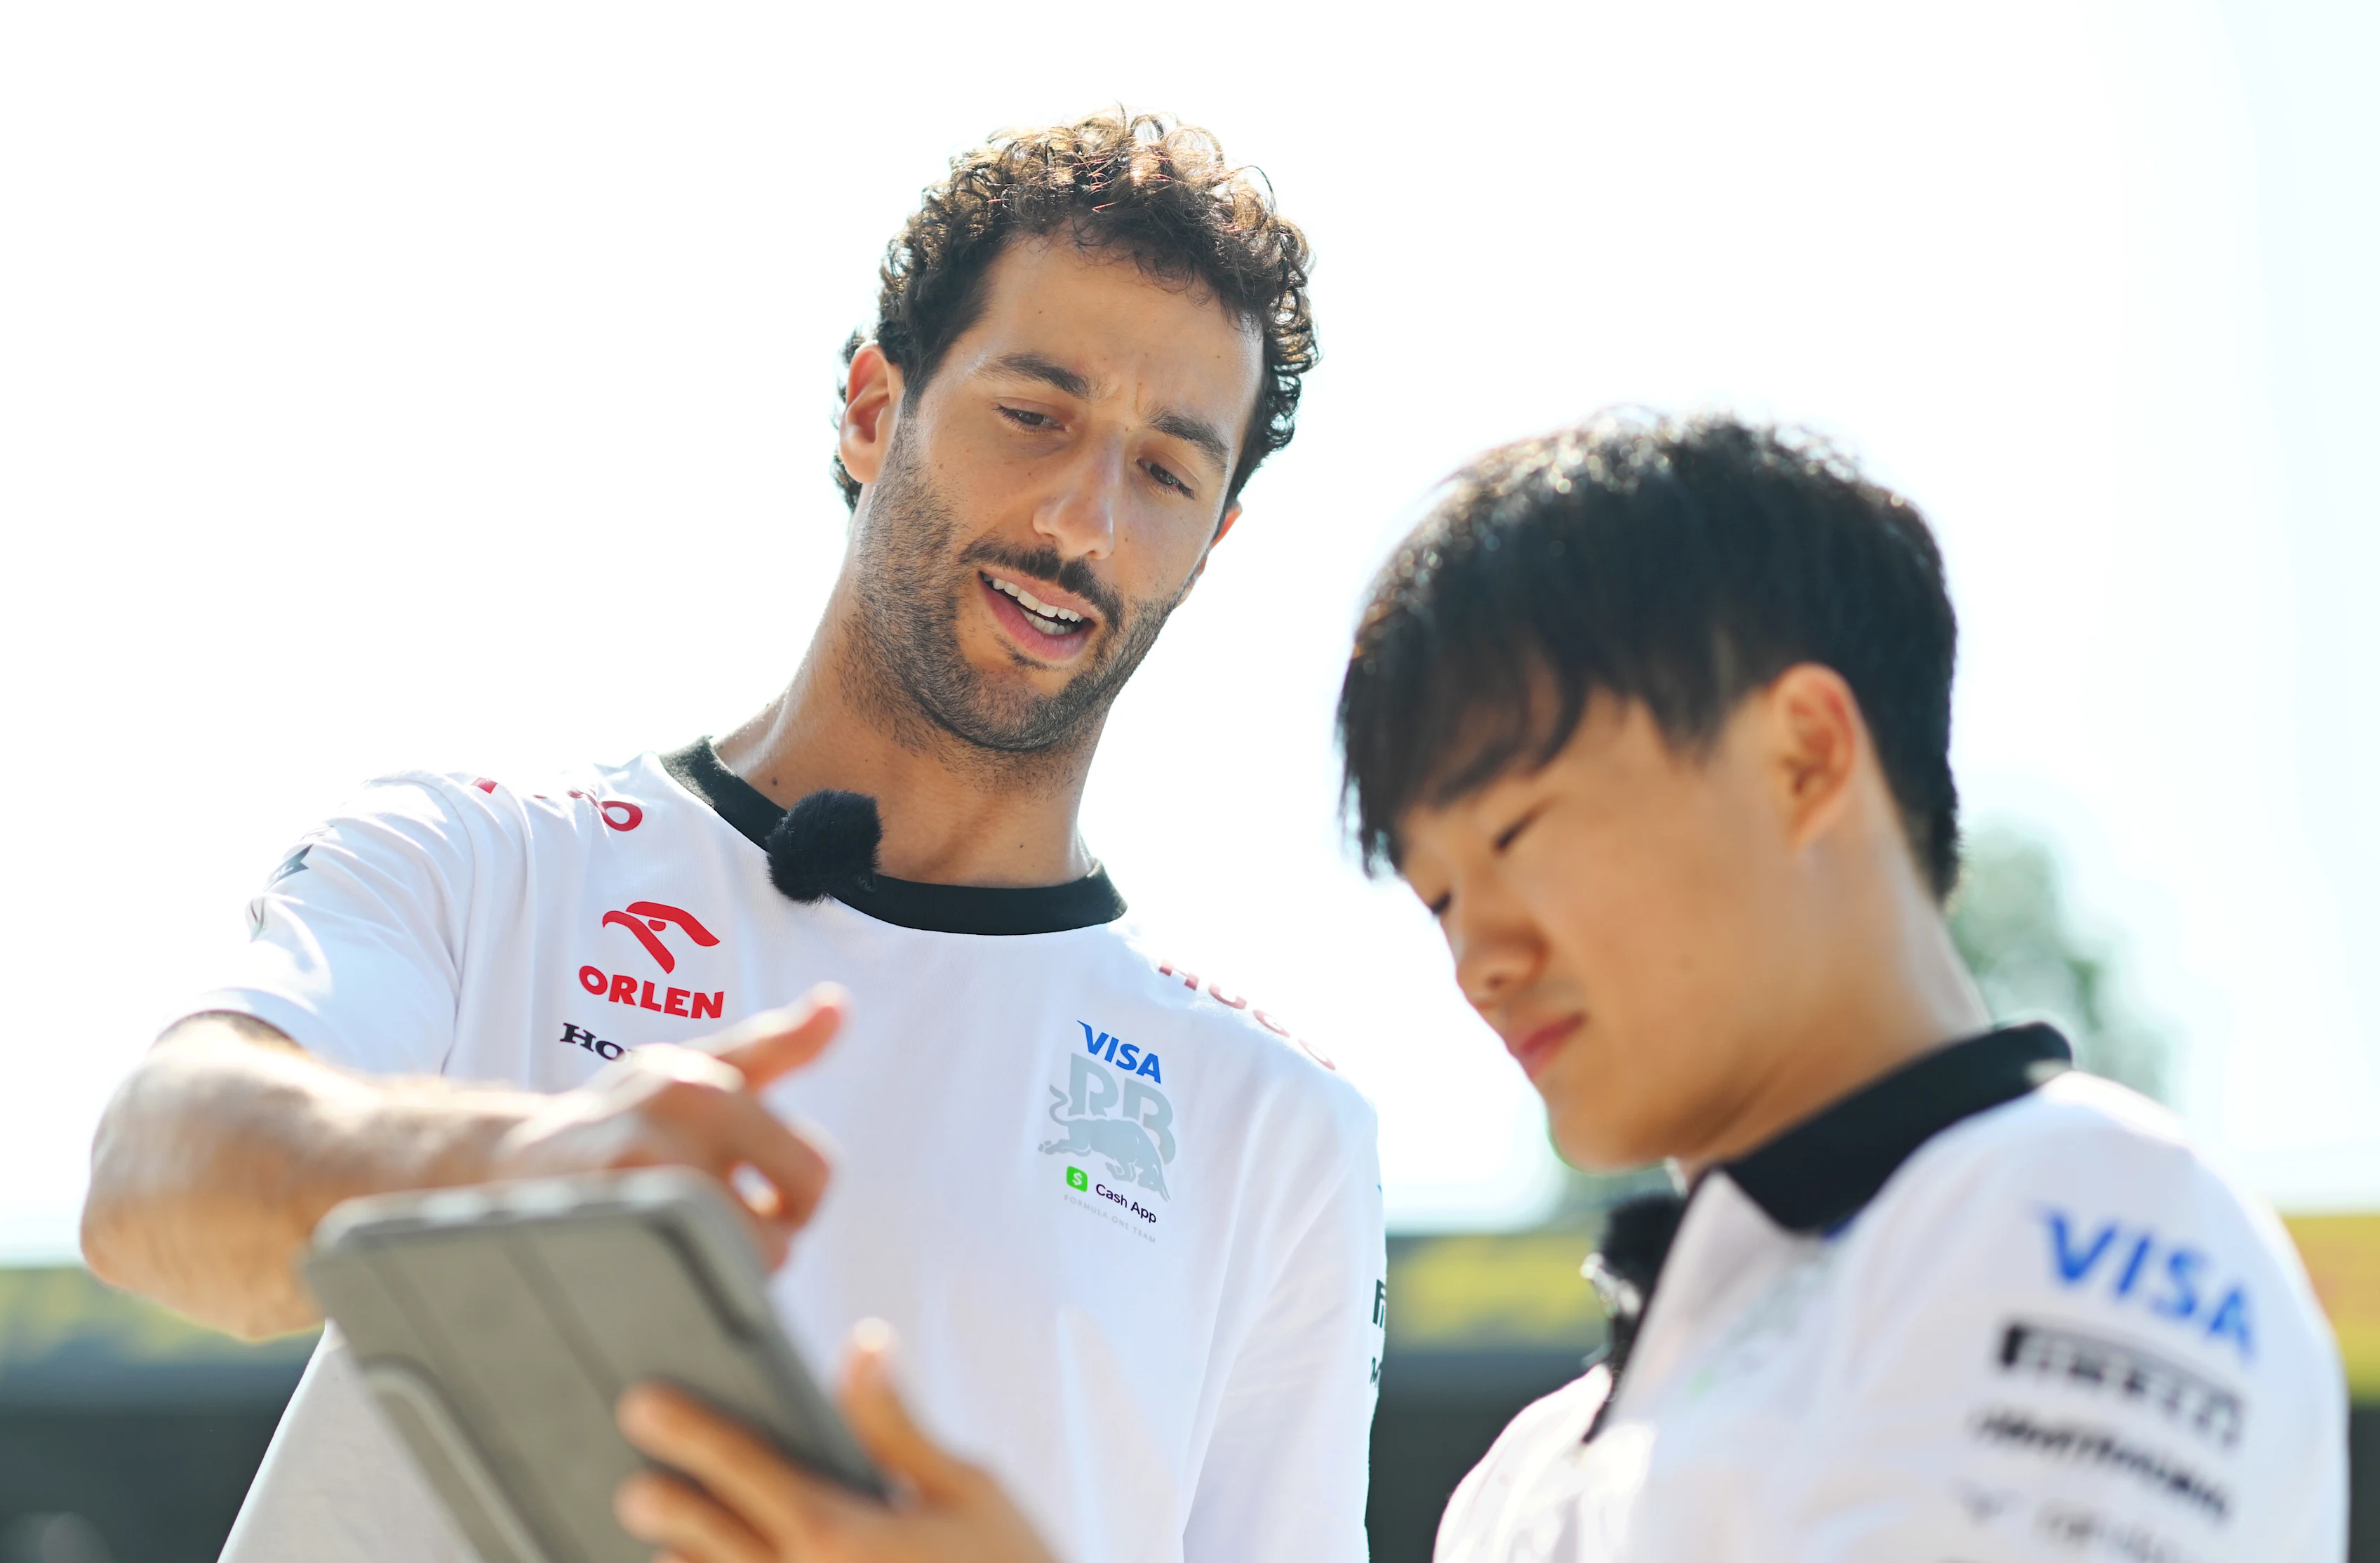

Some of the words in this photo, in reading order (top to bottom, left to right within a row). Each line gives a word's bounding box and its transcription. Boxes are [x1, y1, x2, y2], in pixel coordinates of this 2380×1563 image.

[579, 965, 724, 1019] ORLEN
[1076, 1020, 1161, 1084] VISA
[1064, 1194, 1108, 1219] FORMULA
[1111, 1216, 1129, 1230] ONE
[1132, 1226, 1156, 1244] TEAM
[1095, 1183, 1128, 1208] Cash
[1130, 1202, 1156, 1223] App
[2039, 1204, 2255, 1362] VISA
